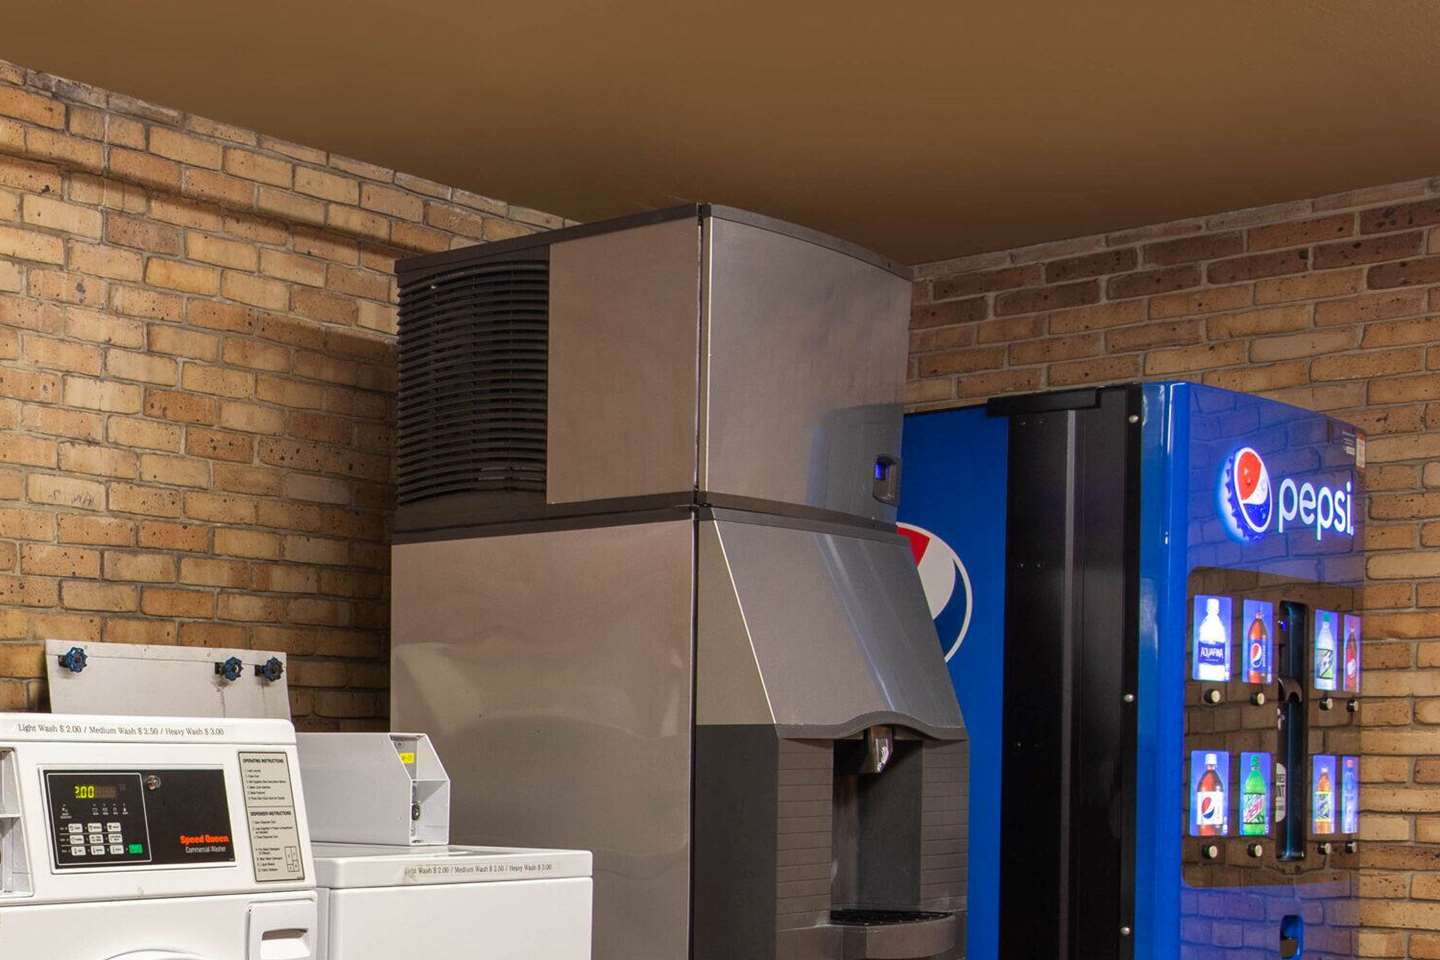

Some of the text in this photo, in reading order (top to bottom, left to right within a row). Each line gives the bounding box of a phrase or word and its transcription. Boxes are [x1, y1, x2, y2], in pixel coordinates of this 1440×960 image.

[1278, 478, 1352, 541] pepsi
[38, 725, 58, 733] Wash
[65, 725, 82, 733] 2.00
[89, 726, 117, 734] Medium
[118, 727, 136, 735] Wash
[180, 833, 229, 845] Speed Queen
